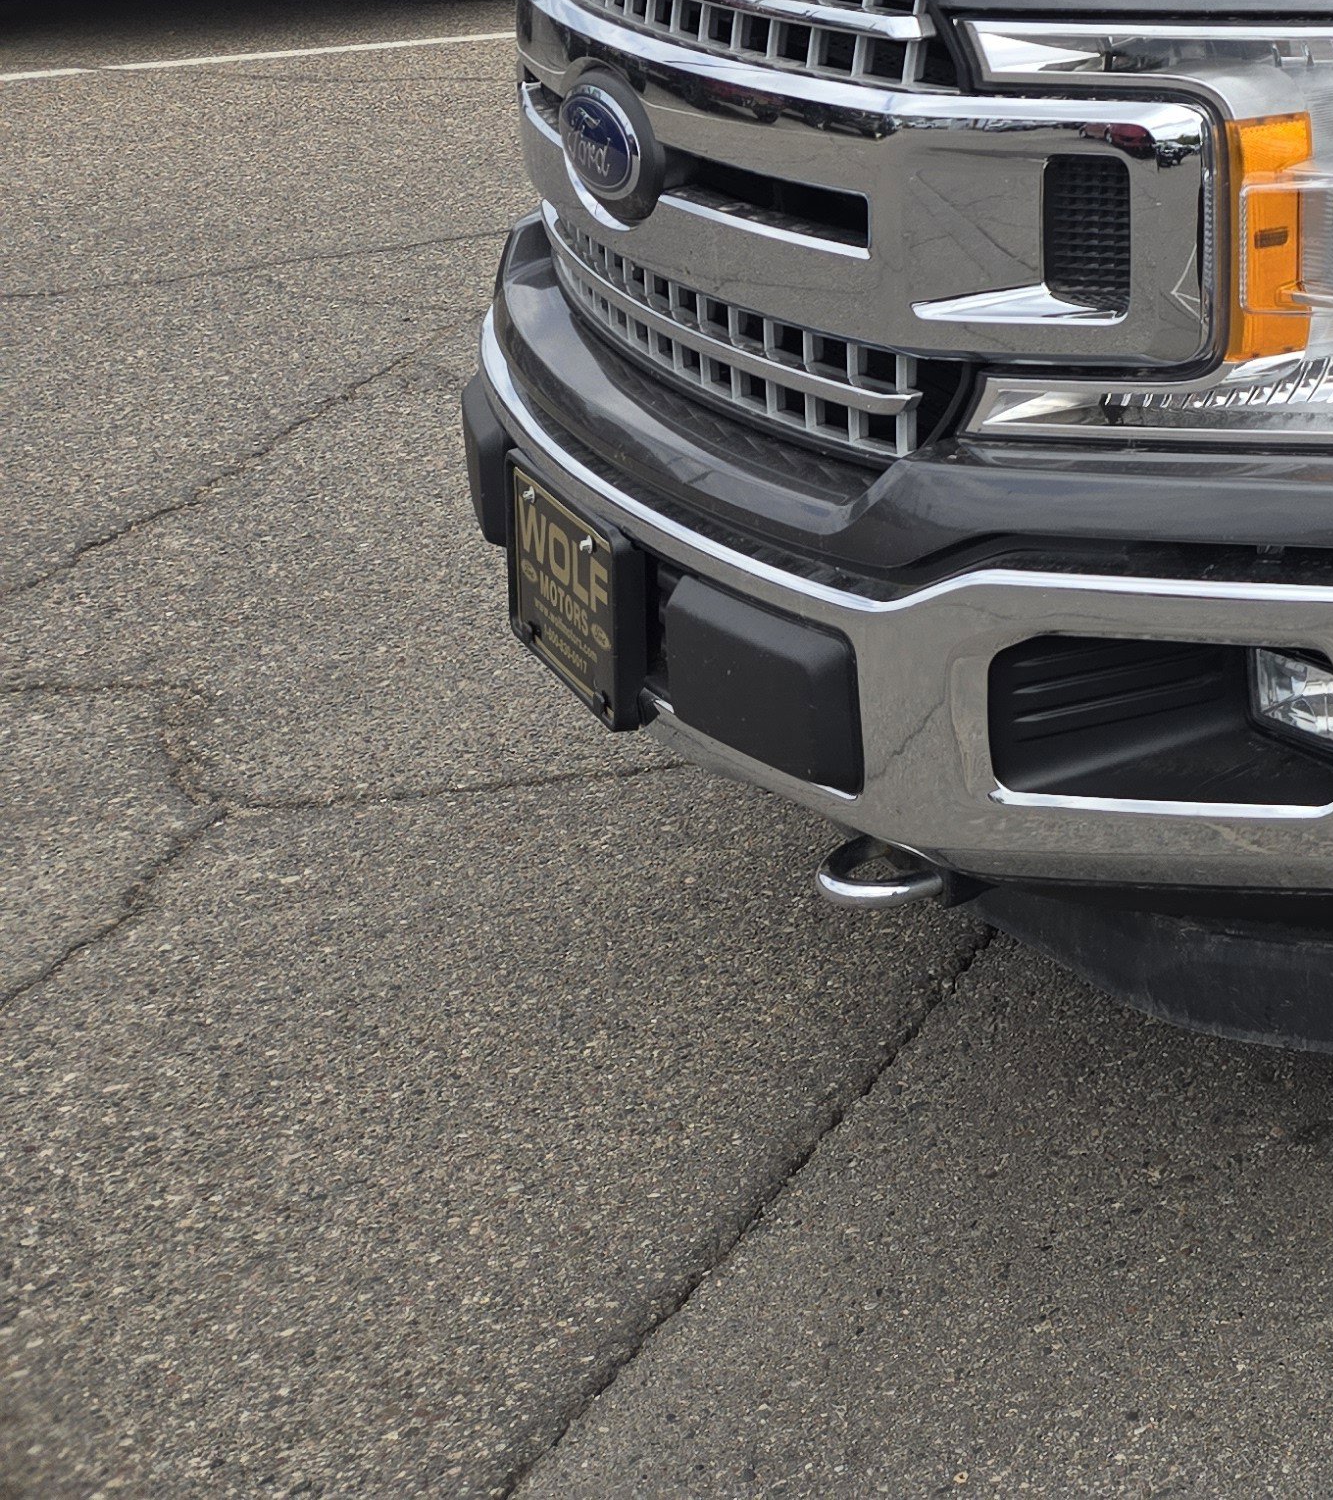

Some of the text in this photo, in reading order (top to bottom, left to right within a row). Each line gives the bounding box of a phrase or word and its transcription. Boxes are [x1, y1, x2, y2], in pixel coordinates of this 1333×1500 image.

[567, 105, 612, 178] Ford
[518, 494, 609, 613] WOLF
[540, 570, 589, 636] MOTORS
